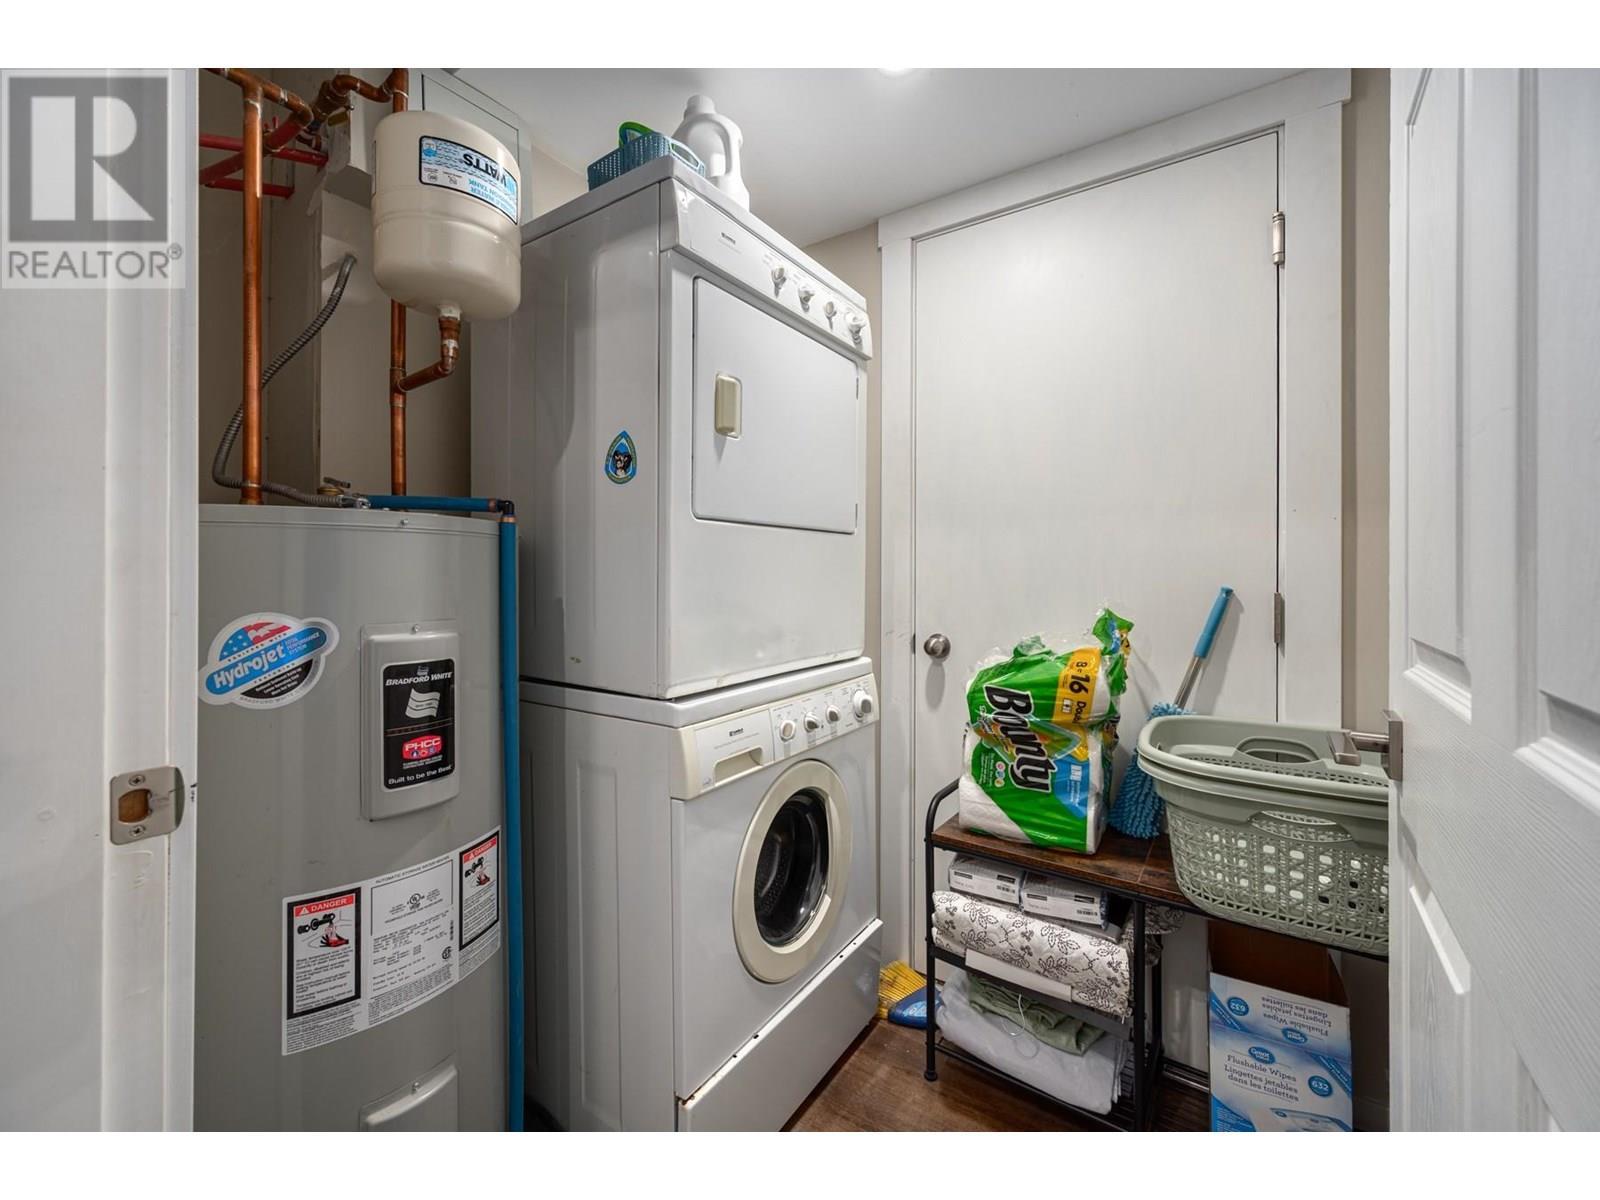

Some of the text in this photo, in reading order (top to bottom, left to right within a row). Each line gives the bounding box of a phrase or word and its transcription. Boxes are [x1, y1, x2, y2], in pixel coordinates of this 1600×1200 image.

[463, 153, 507, 188] WATTS
[213, 643, 287, 688] Hydrojet
[385, 672, 453, 686] BRADFORD WHITE
[1069, 674, 1091, 695] 16
[405, 737, 441, 751] PHCC
[983, 684, 1058, 793] Bounty
[388, 776, 405, 785] Built
[426, 769, 438, 777] the
[438, 764, 452, 773] Best
[311, 898, 348, 912] DANGER
[1263, 1012, 1288, 1025] Wipes
[1294, 1004, 1306, 1014] les
[1307, 1007, 1328, 1019] dans
[1294, 1010, 1332, 1028] Lingettes
[1227, 1054, 1267, 1073] Flushable
[1269, 1068, 1297, 1082] Wipes
[1224, 1064, 1298, 1094] Lingettes jetables
[1228, 1074, 1299, 1102] dans les toilettes
[1311, 1080, 1329, 1092] 632
